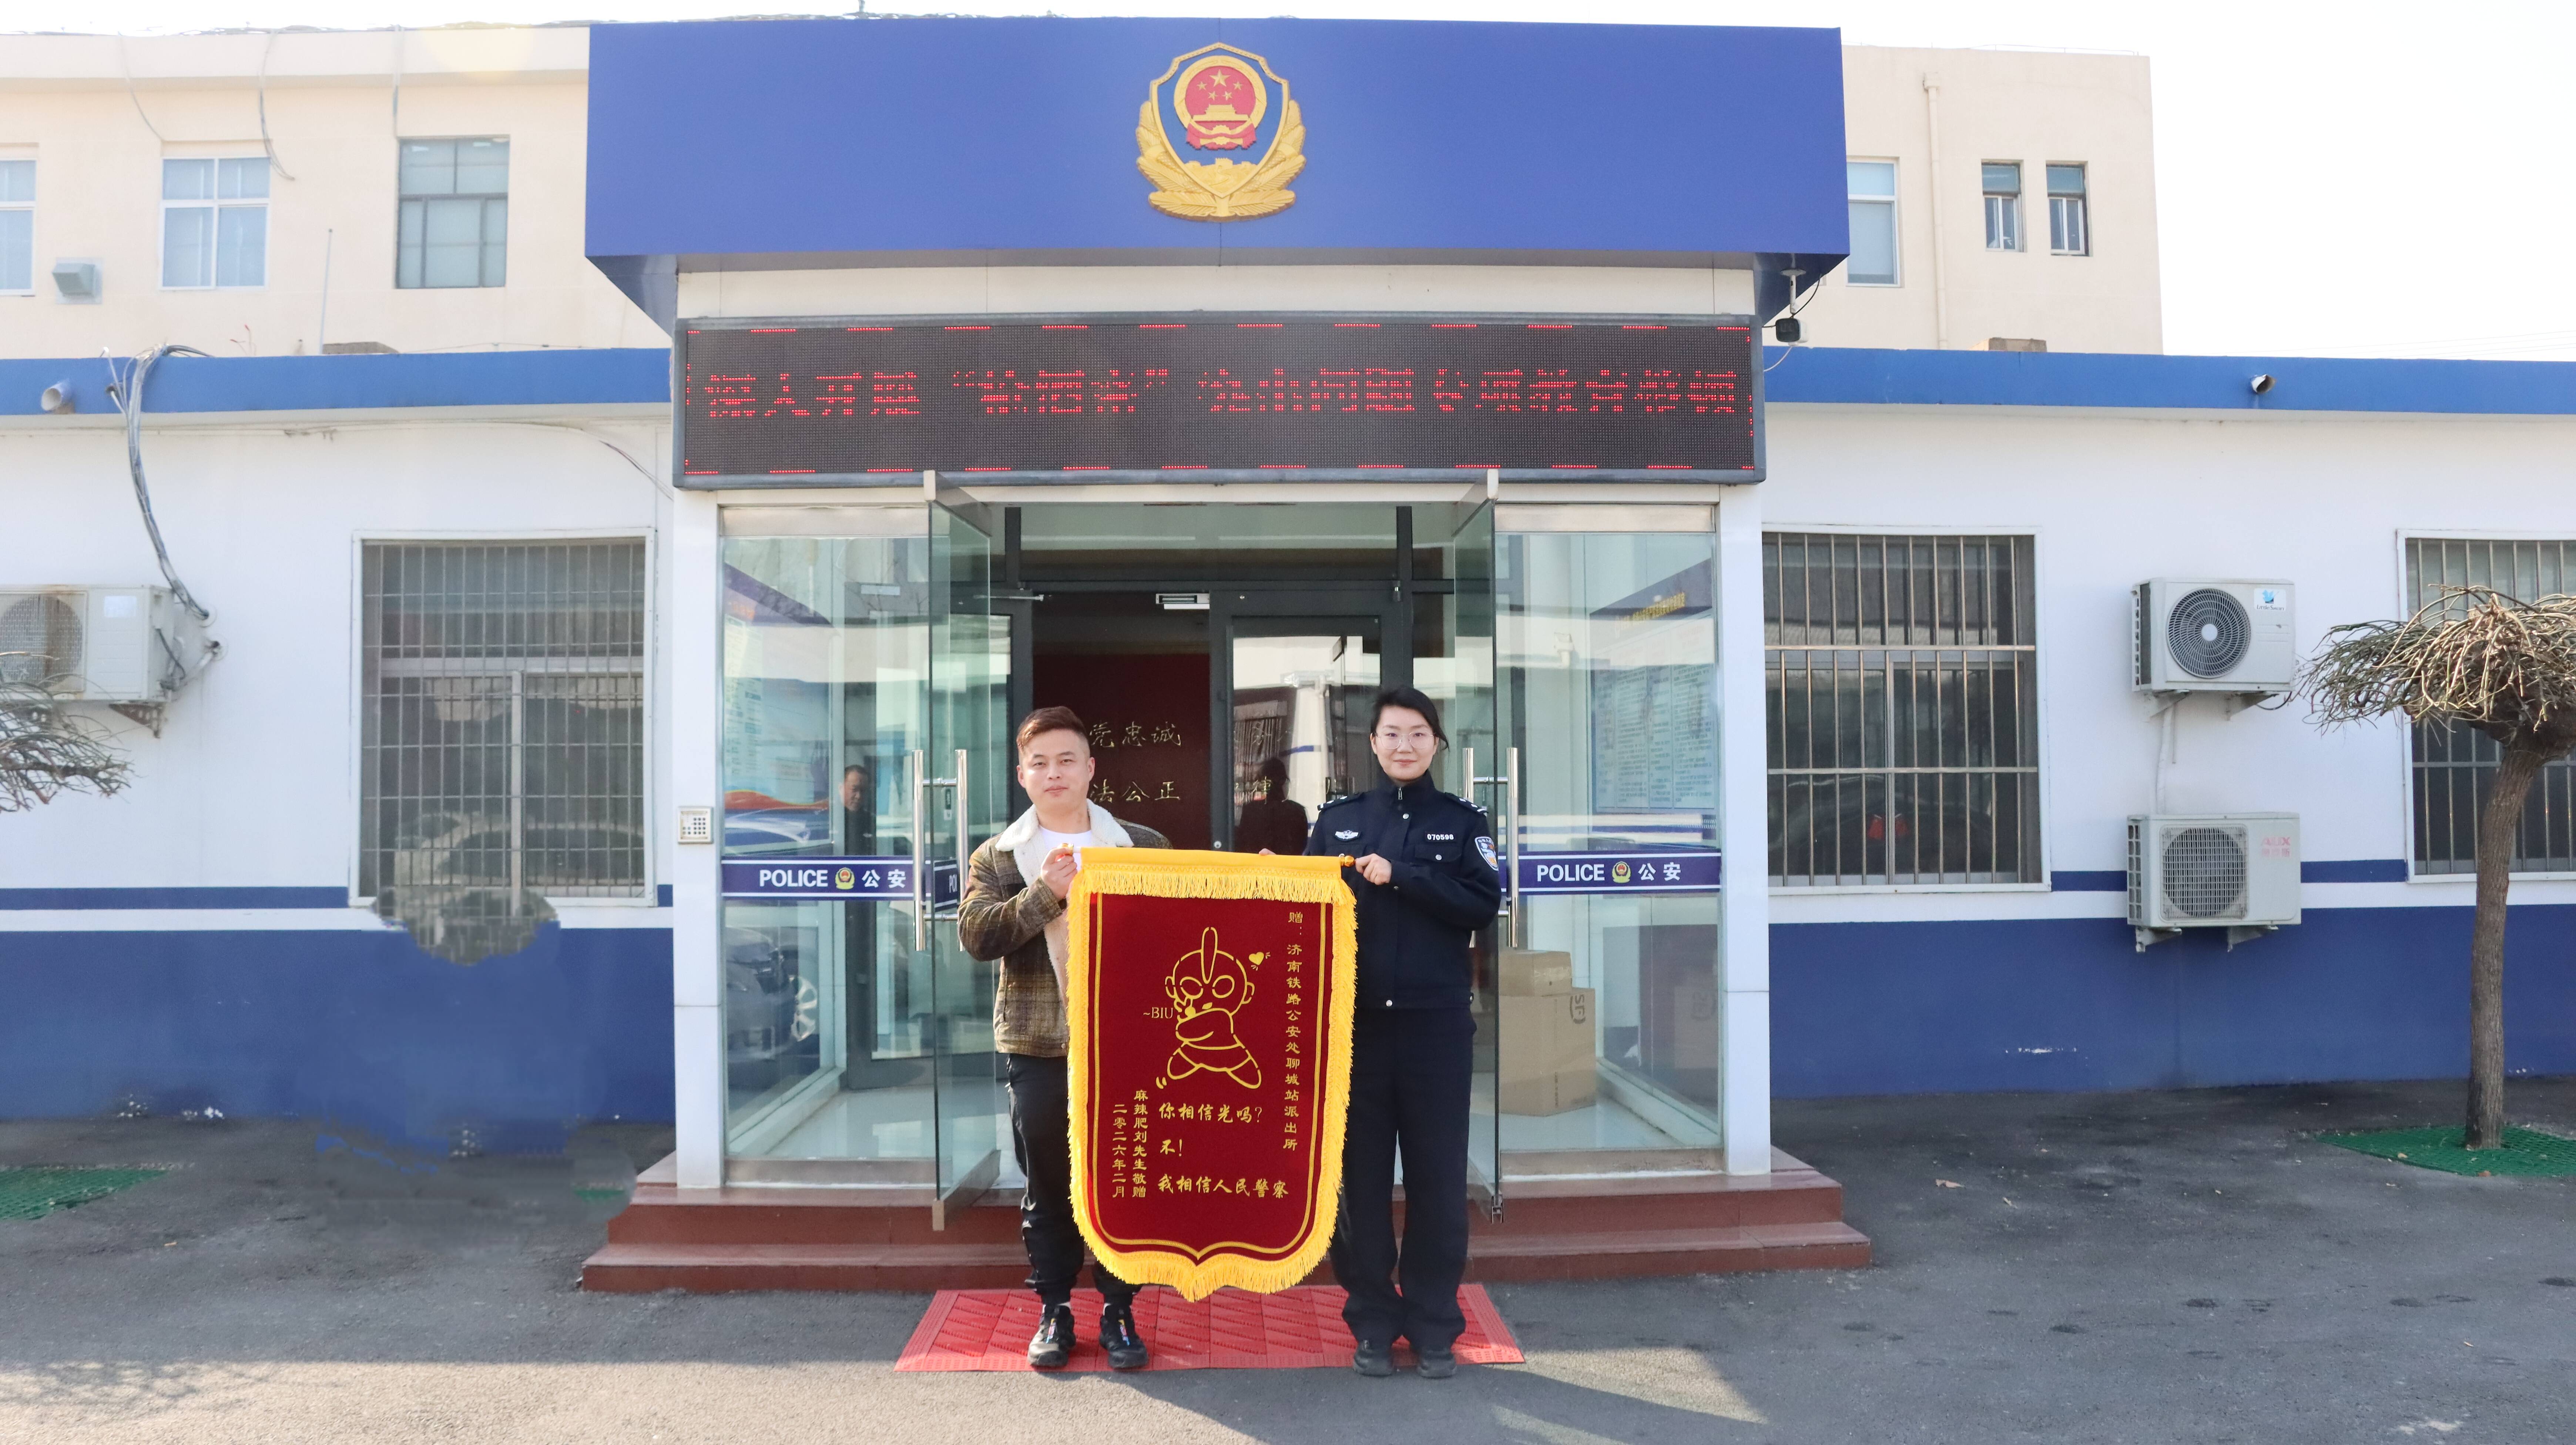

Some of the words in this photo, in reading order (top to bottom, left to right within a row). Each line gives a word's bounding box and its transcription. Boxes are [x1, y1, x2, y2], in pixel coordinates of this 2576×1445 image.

[759, 869, 829, 888] POLICE
[862, 869, 907, 889] 公安
[1537, 864, 1606, 882] POLICE
[1638, 862, 1682, 882] 公安
[1111, 1104, 1128, 1199] 二零二六年二月
[1132, 1089, 1149, 1198] 麻辣肥刘先生敬赠
[1158, 1174, 1289, 1200] 我相信人民警察
